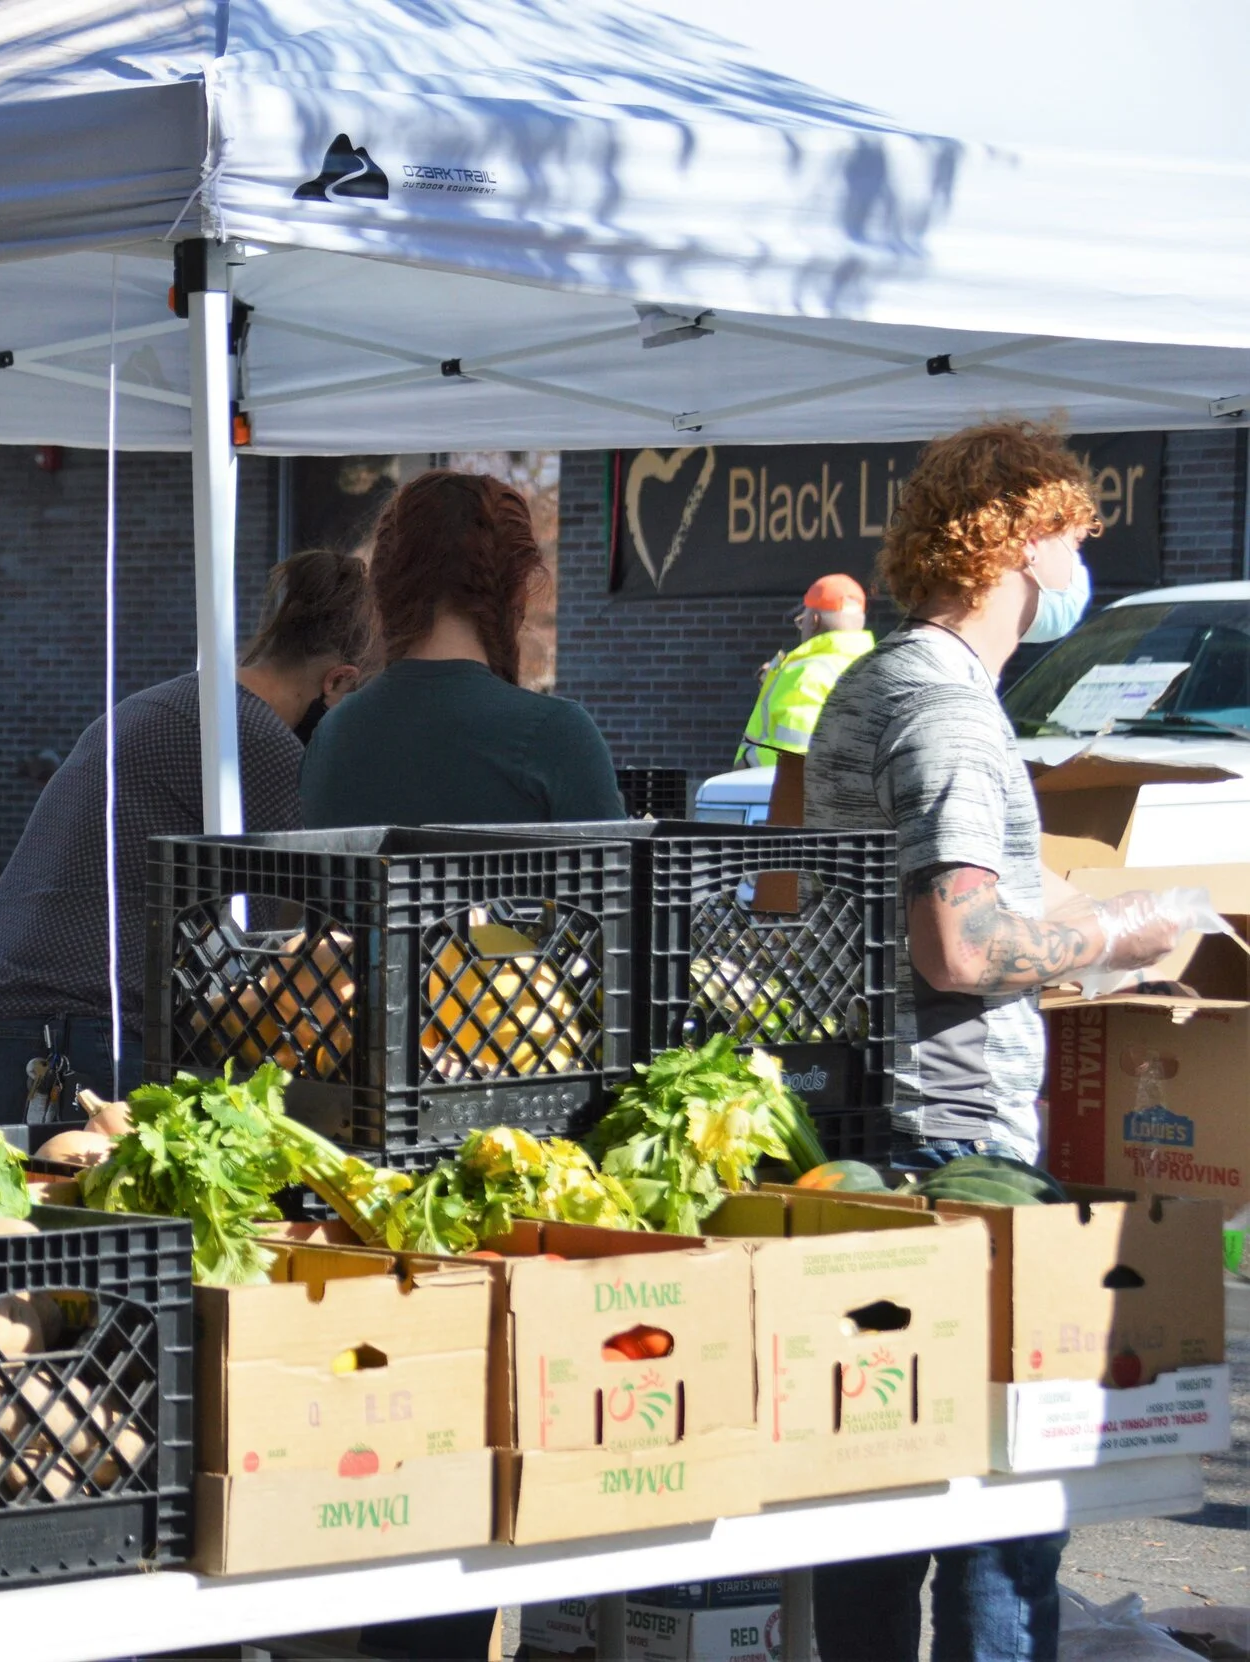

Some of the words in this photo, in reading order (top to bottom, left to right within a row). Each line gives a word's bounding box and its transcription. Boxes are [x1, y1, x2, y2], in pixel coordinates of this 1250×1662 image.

[402, 181, 444, 190] OUTDOOR
[446, 184, 497, 195] EQUIPMENT
[727, 462, 844, 543] Black
[1083, 450, 1145, 528] er
[1077, 1006, 1104, 1117] SMALL
[506, 1091, 576, 1122] Foods
[1164, 1151, 1194, 1164] STOP
[364, 1389, 413, 1425] LG
[843, 1407, 903, 1424] CALIFORNIA
[847, 1420, 900, 1434] TOMATOES
[1120, 1415, 1171, 1431] CALIFORNIA
[1174, 1411, 1209, 1426] CENTRAL
[609, 1435, 671, 1450] CALIFORNIA
[716, 1579, 751, 1594] STARTS
[751, 1577, 783, 1592] WORK
[558, 1599, 586, 1619] RED
[546, 1619, 582, 1636] CALIFORNIA
[730, 1626, 759, 1648] RED
